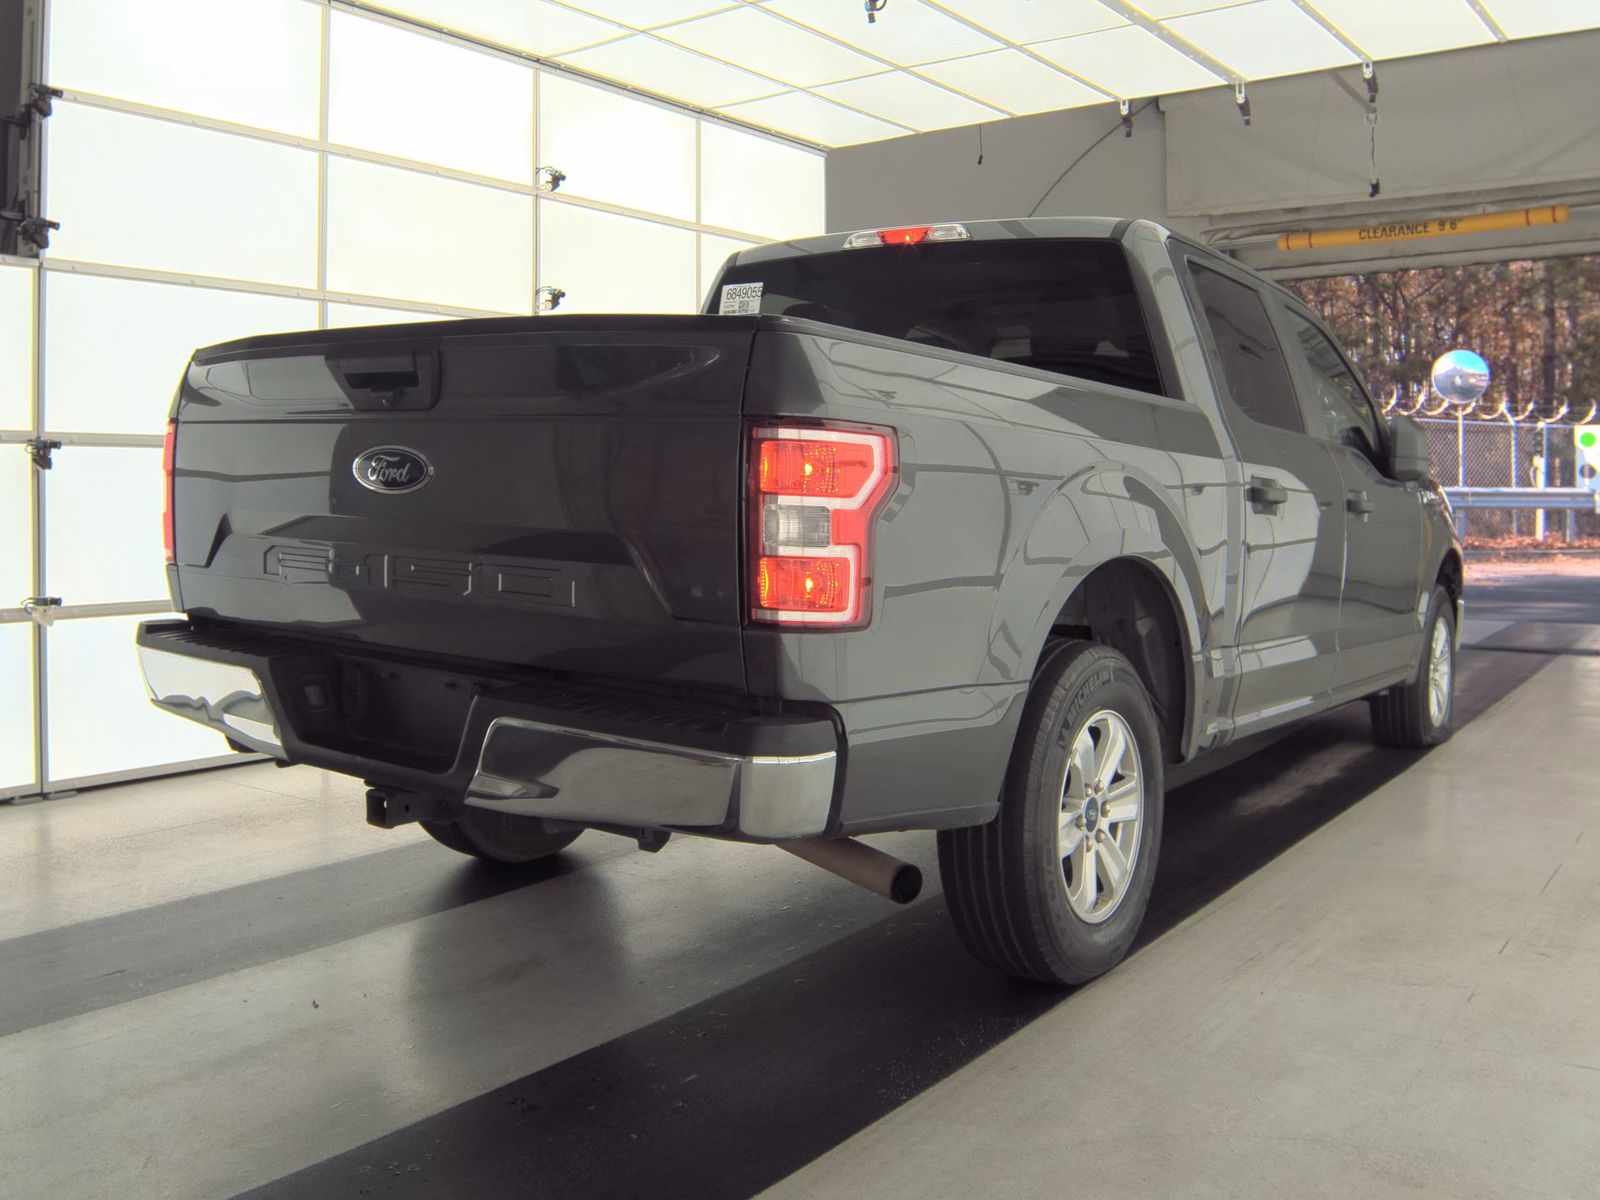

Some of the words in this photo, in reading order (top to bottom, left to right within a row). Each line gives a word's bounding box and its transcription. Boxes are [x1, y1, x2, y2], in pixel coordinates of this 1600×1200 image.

[1359, 221, 1430, 240] CLEARANCE
[367, 455, 411, 482] Ford
[1067, 666, 1112, 727] MICHELIN
